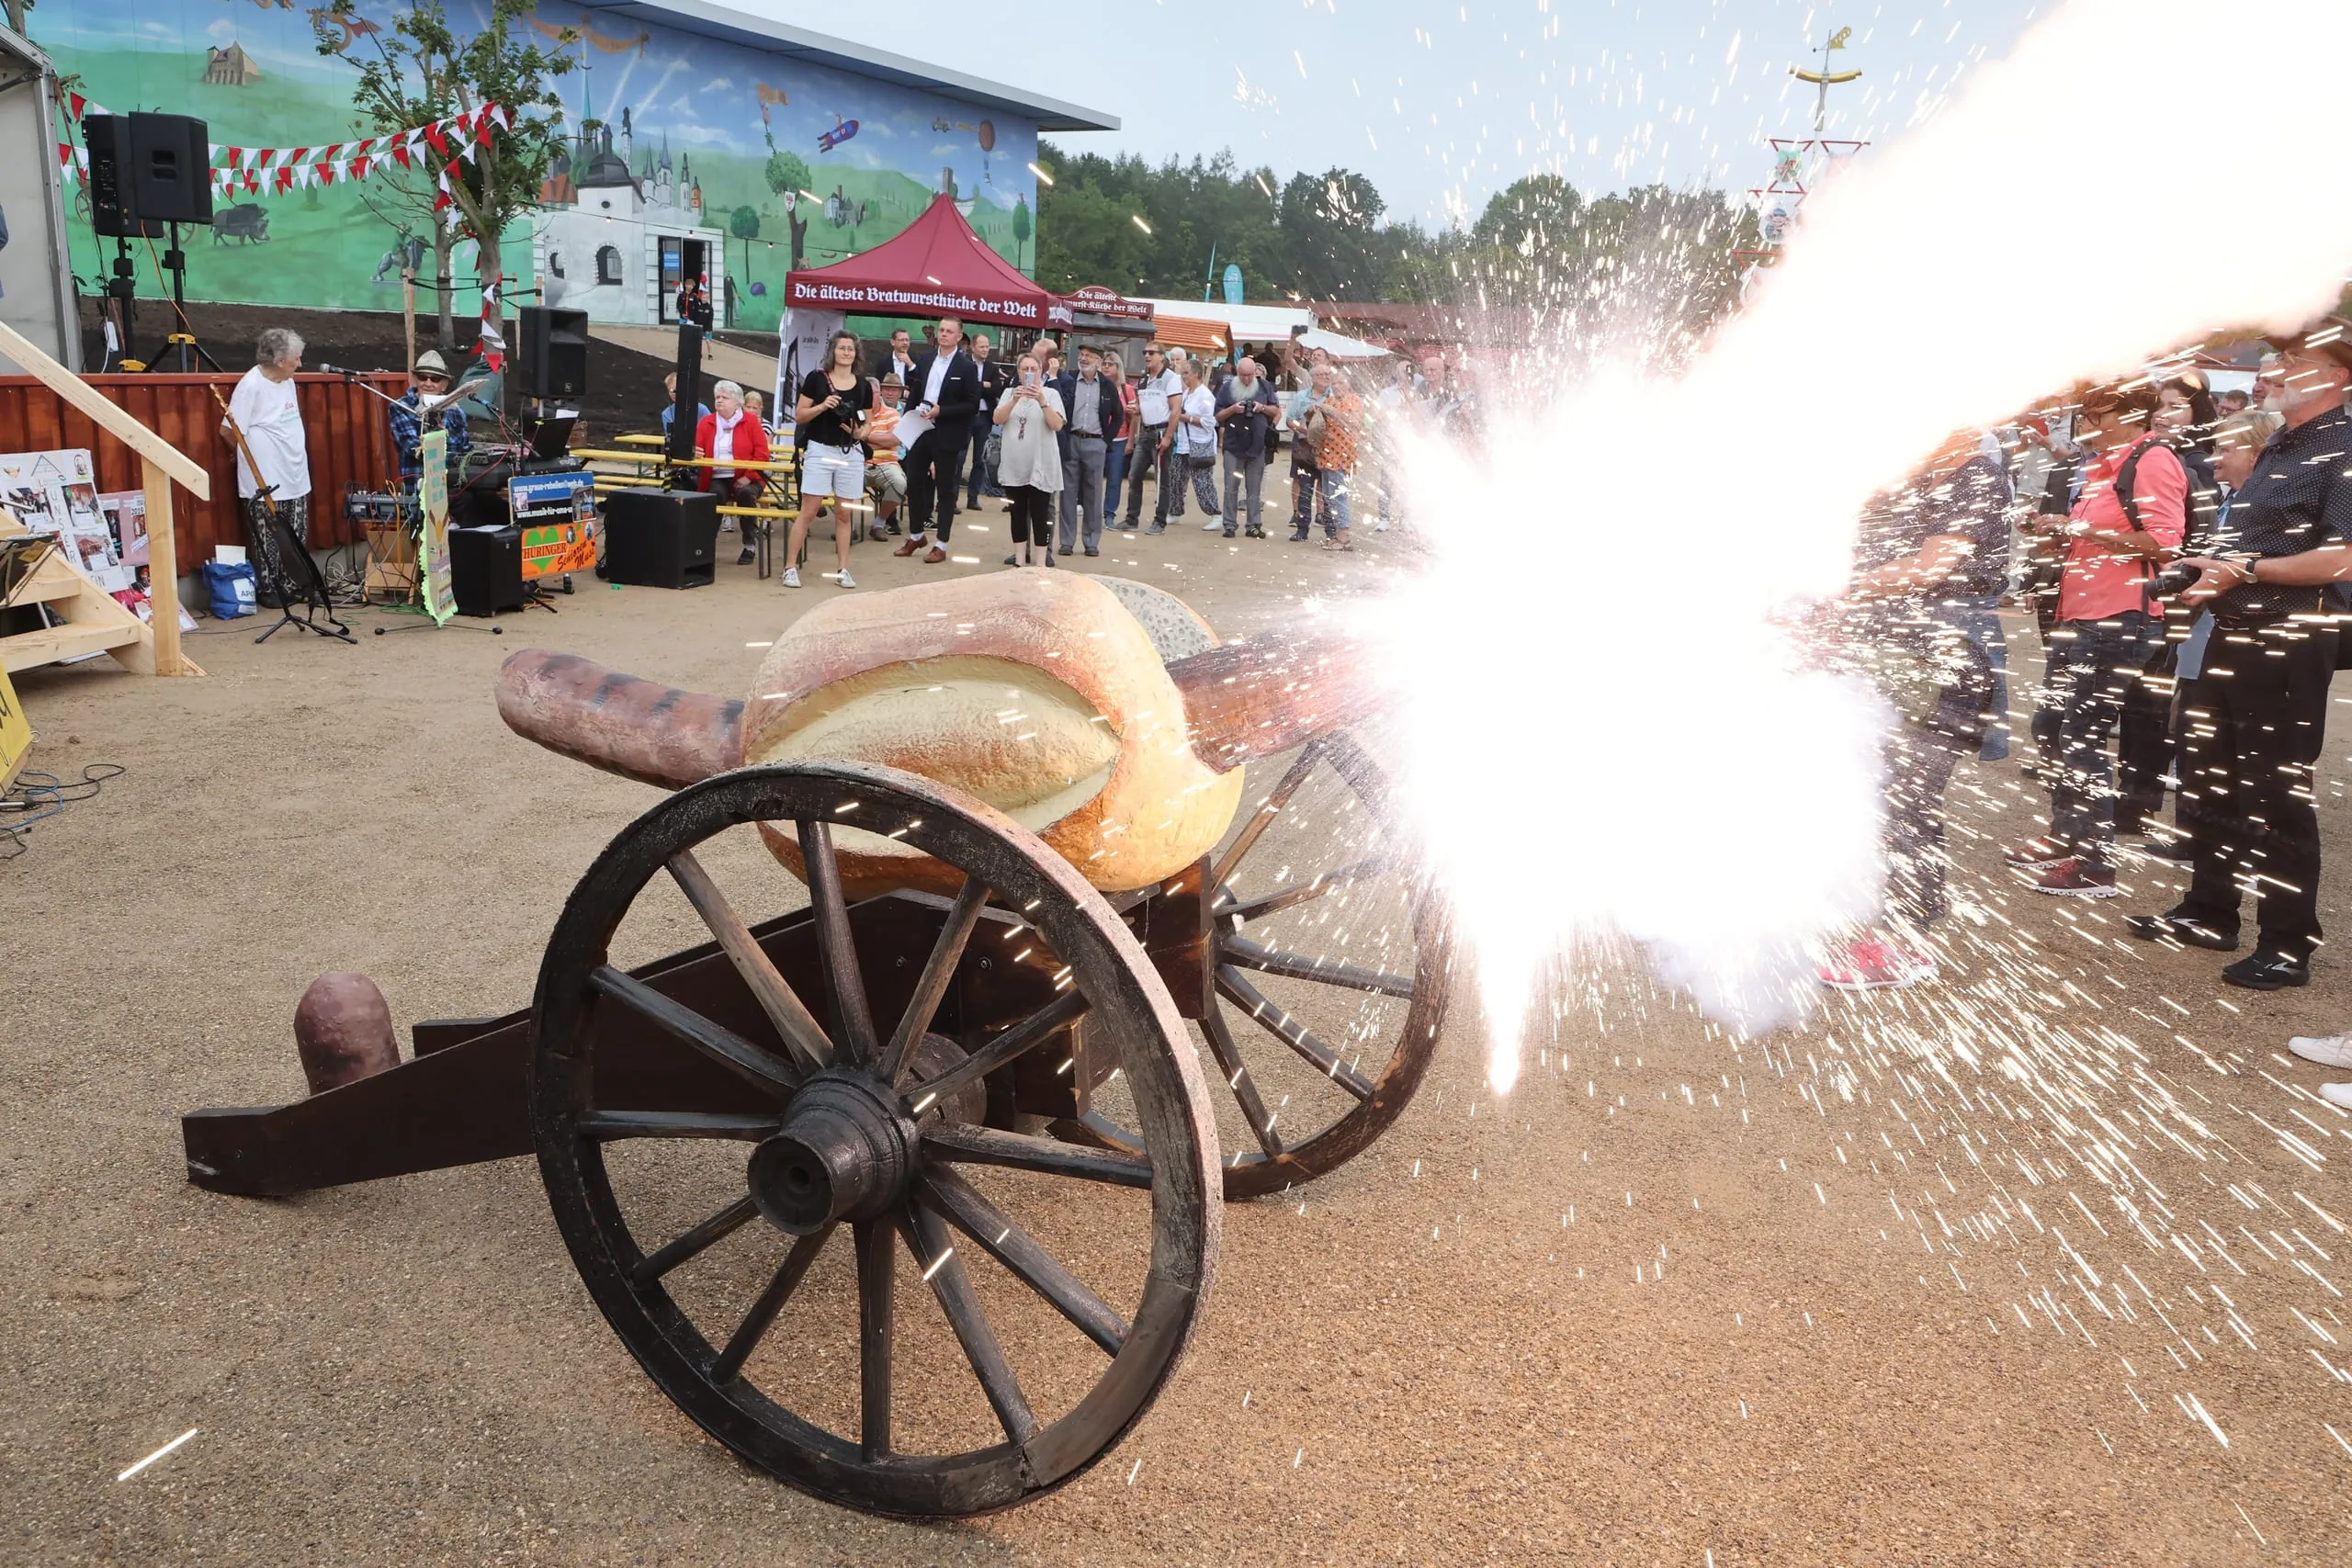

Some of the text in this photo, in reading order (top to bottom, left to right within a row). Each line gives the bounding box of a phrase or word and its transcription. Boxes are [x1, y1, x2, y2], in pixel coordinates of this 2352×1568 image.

[795, 283, 818, 299] Die
[820, 286, 864, 301] älteste
[867, 288, 977, 310] Bratwurstküche
[979, 299, 1000, 313] der
[1003, 299, 1037, 319] Welt
[1078, 290, 1093, 299] Die
[131, 506, 145, 515] 2019
[522, 542, 568, 559] HÜRINGER
